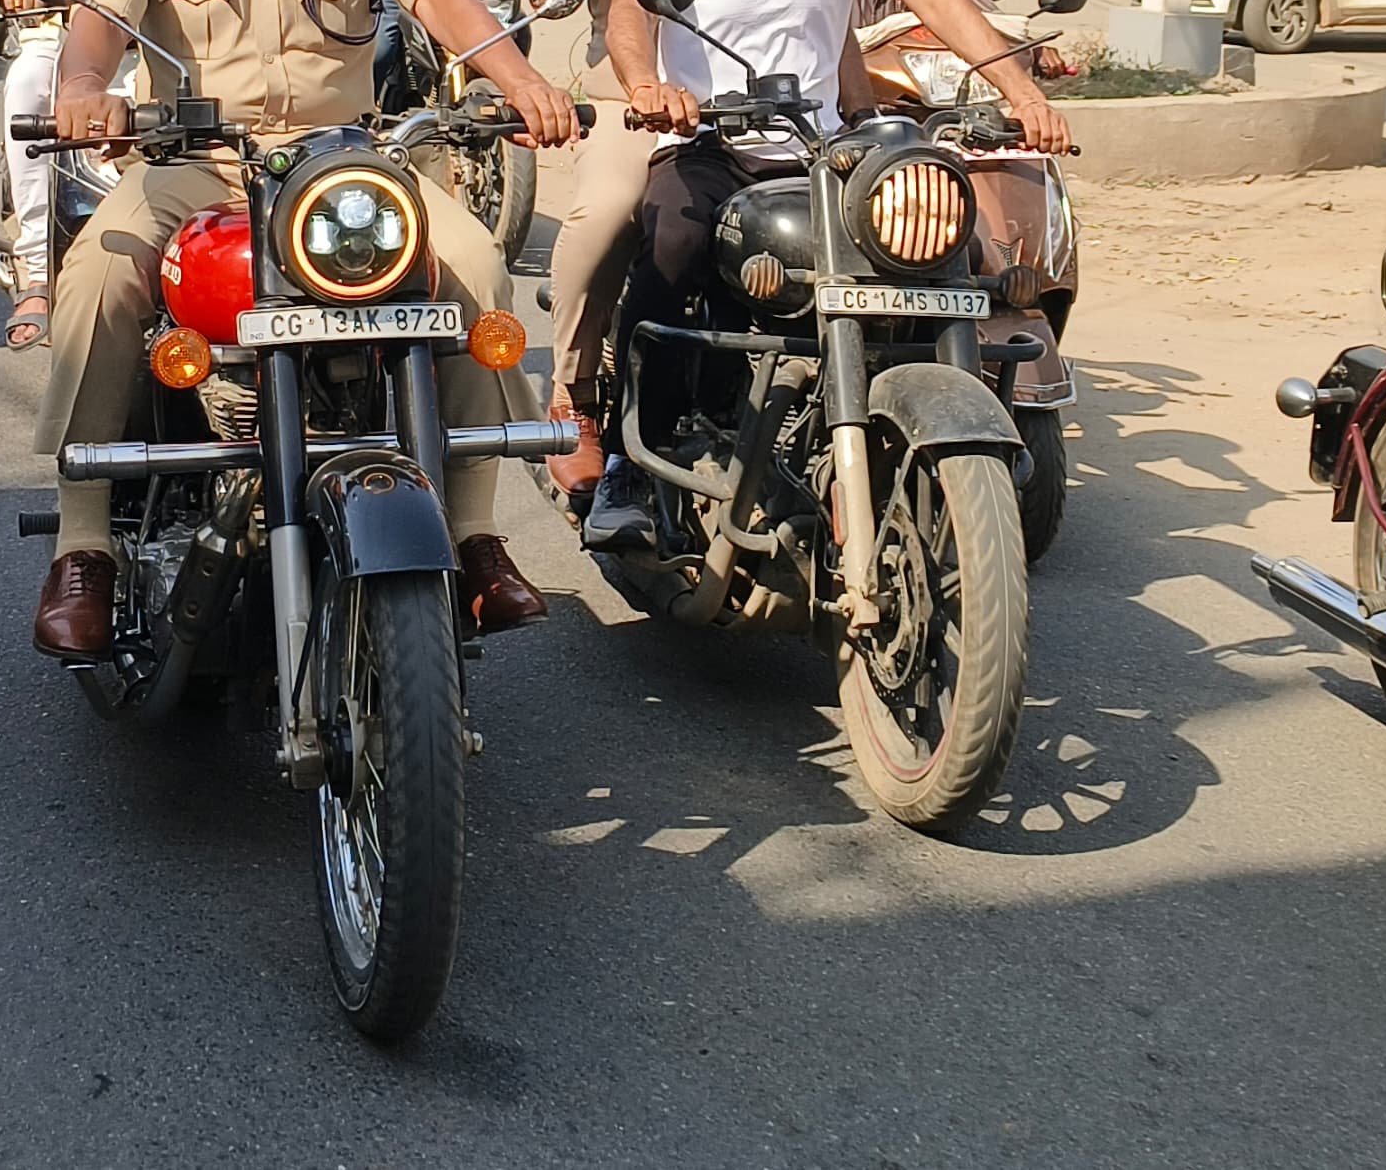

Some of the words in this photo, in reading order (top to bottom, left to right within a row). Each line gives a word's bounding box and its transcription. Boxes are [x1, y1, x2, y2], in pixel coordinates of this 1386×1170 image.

[843, 290, 868, 309] CG
[937, 293, 986, 314] 0137
[271, 314, 302, 338] CG
[320, 308, 382, 335] 13AK
[395, 308, 457, 331] 8720
